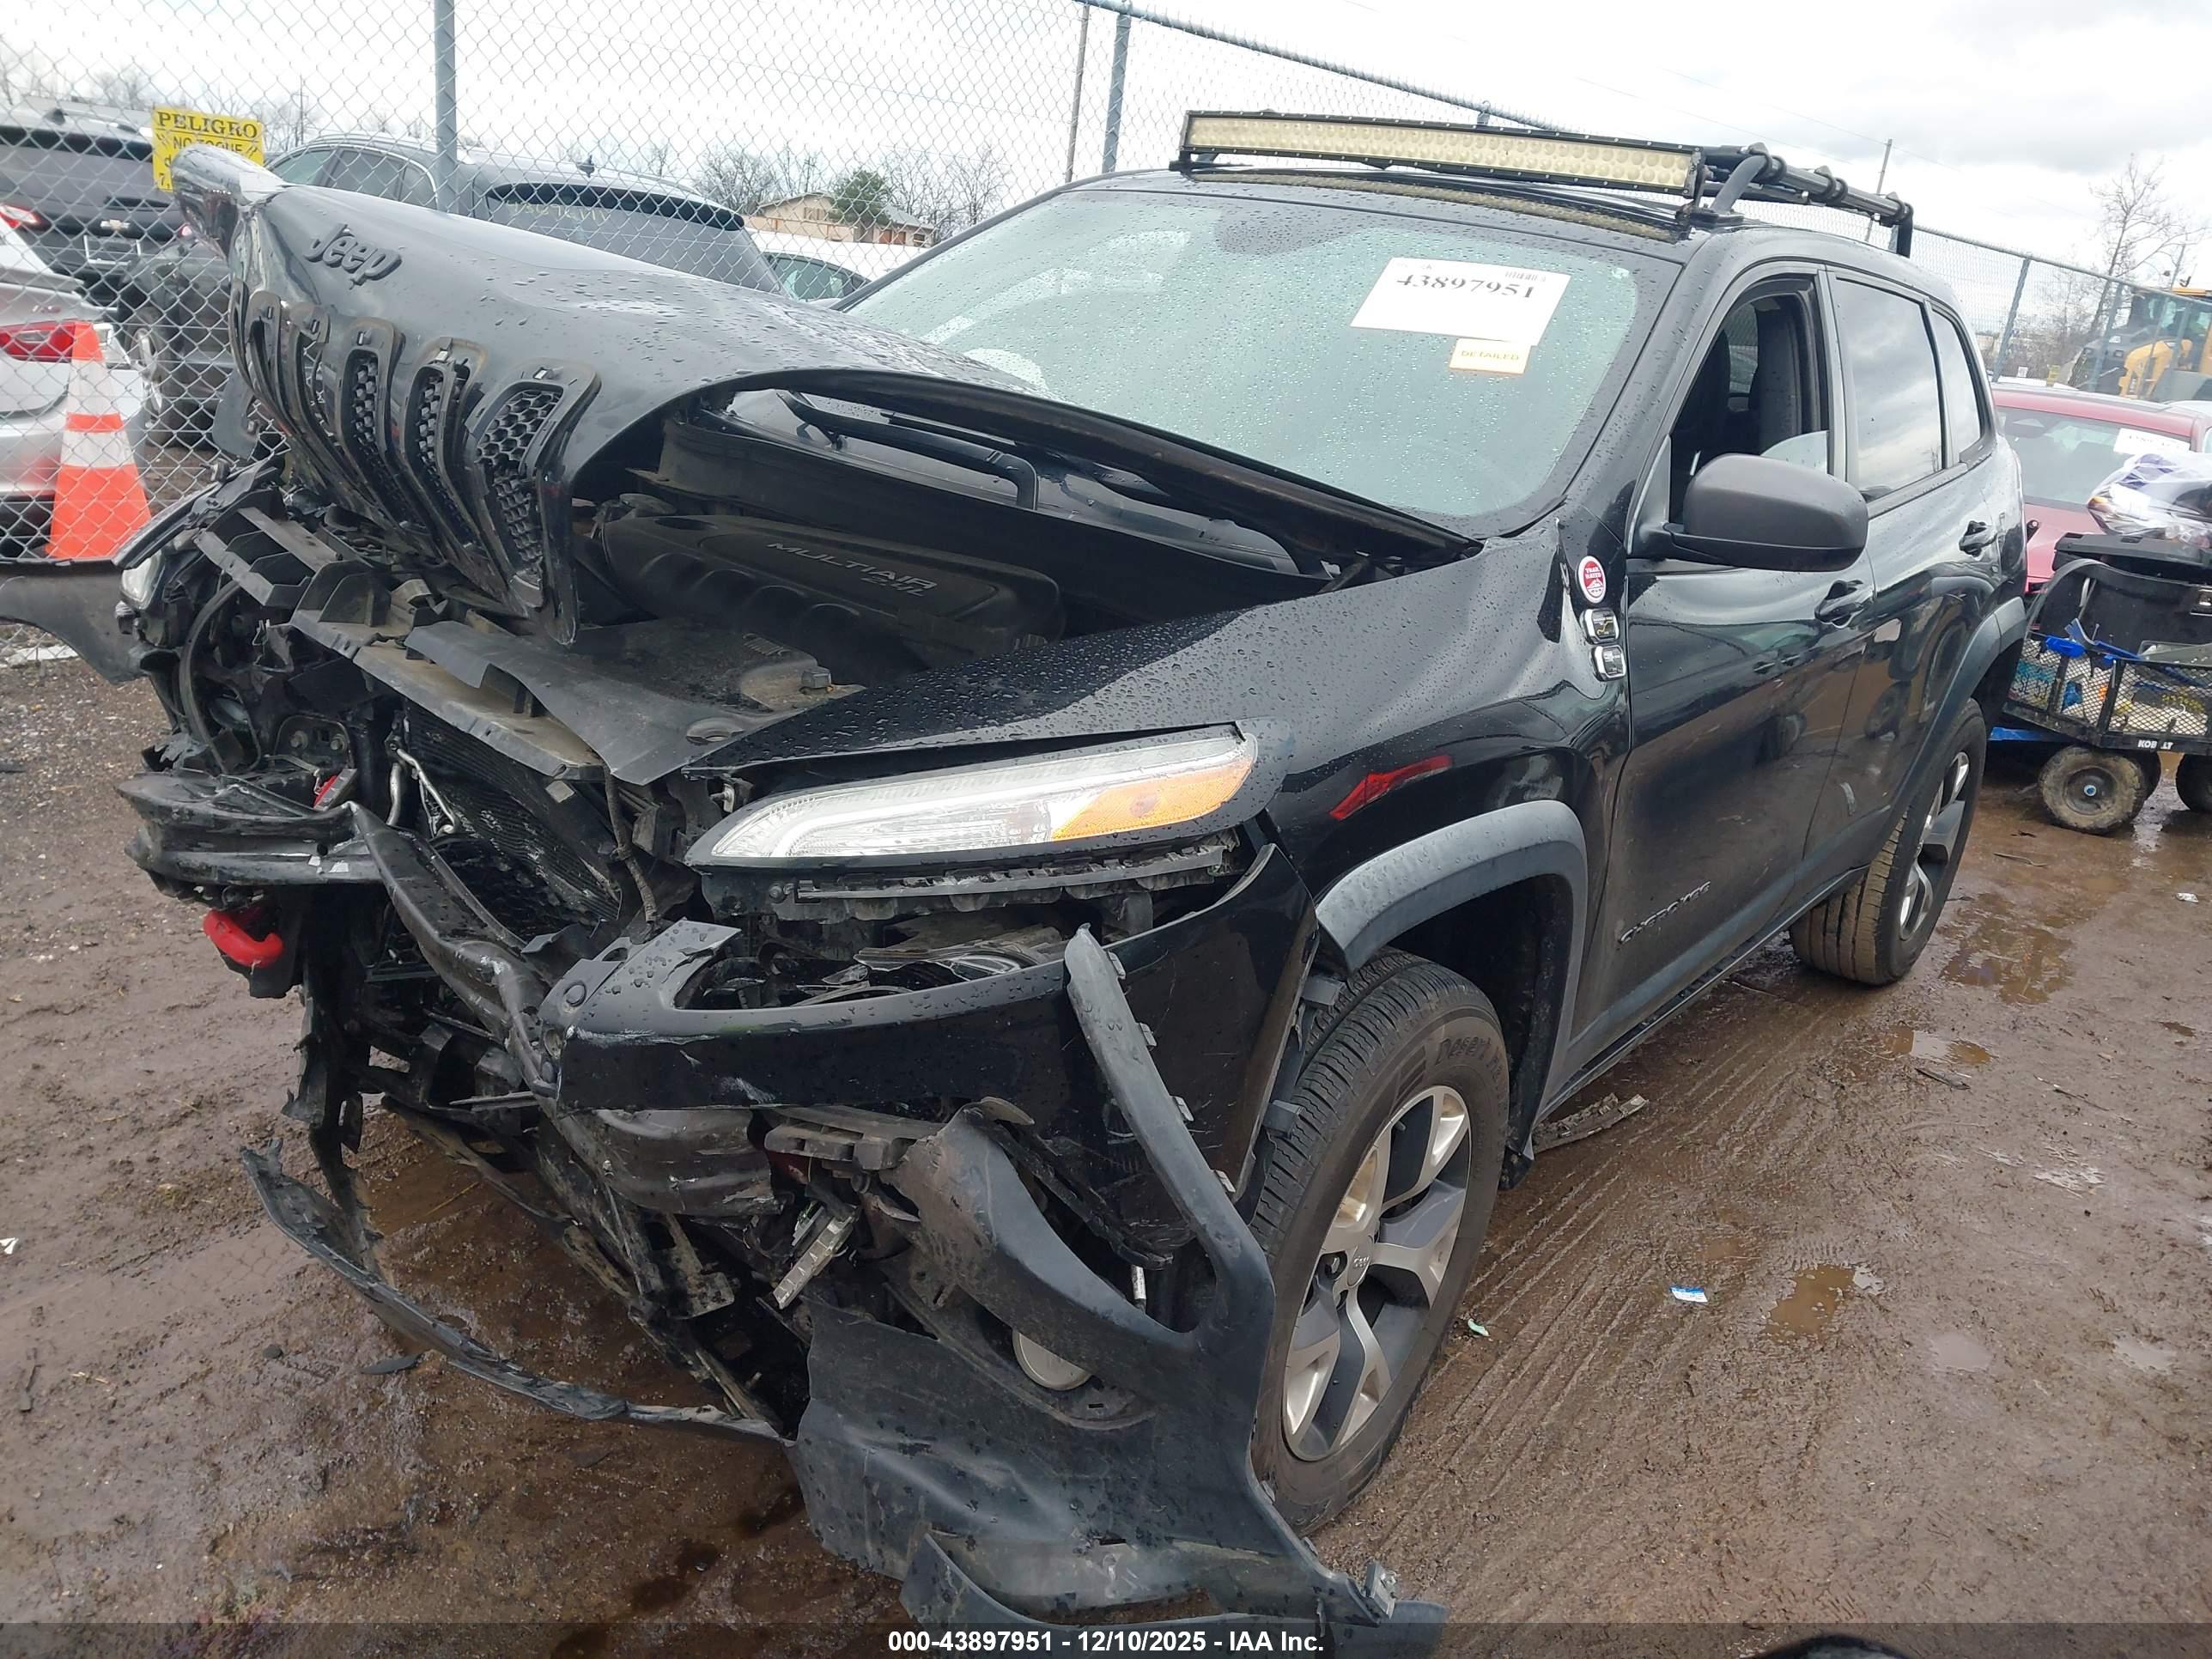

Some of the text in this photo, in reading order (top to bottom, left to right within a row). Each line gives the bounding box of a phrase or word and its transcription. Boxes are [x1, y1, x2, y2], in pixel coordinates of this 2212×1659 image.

[157, 111, 258, 138] PELIGRO
[303, 222, 403, 286] Jeep
[1396, 274, 1535, 298] 43897951
[1461, 350, 1519, 360] DETAILED
[766, 542, 938, 589] MULTIAIR
[2137, 739, 2174, 750] KOBLT
